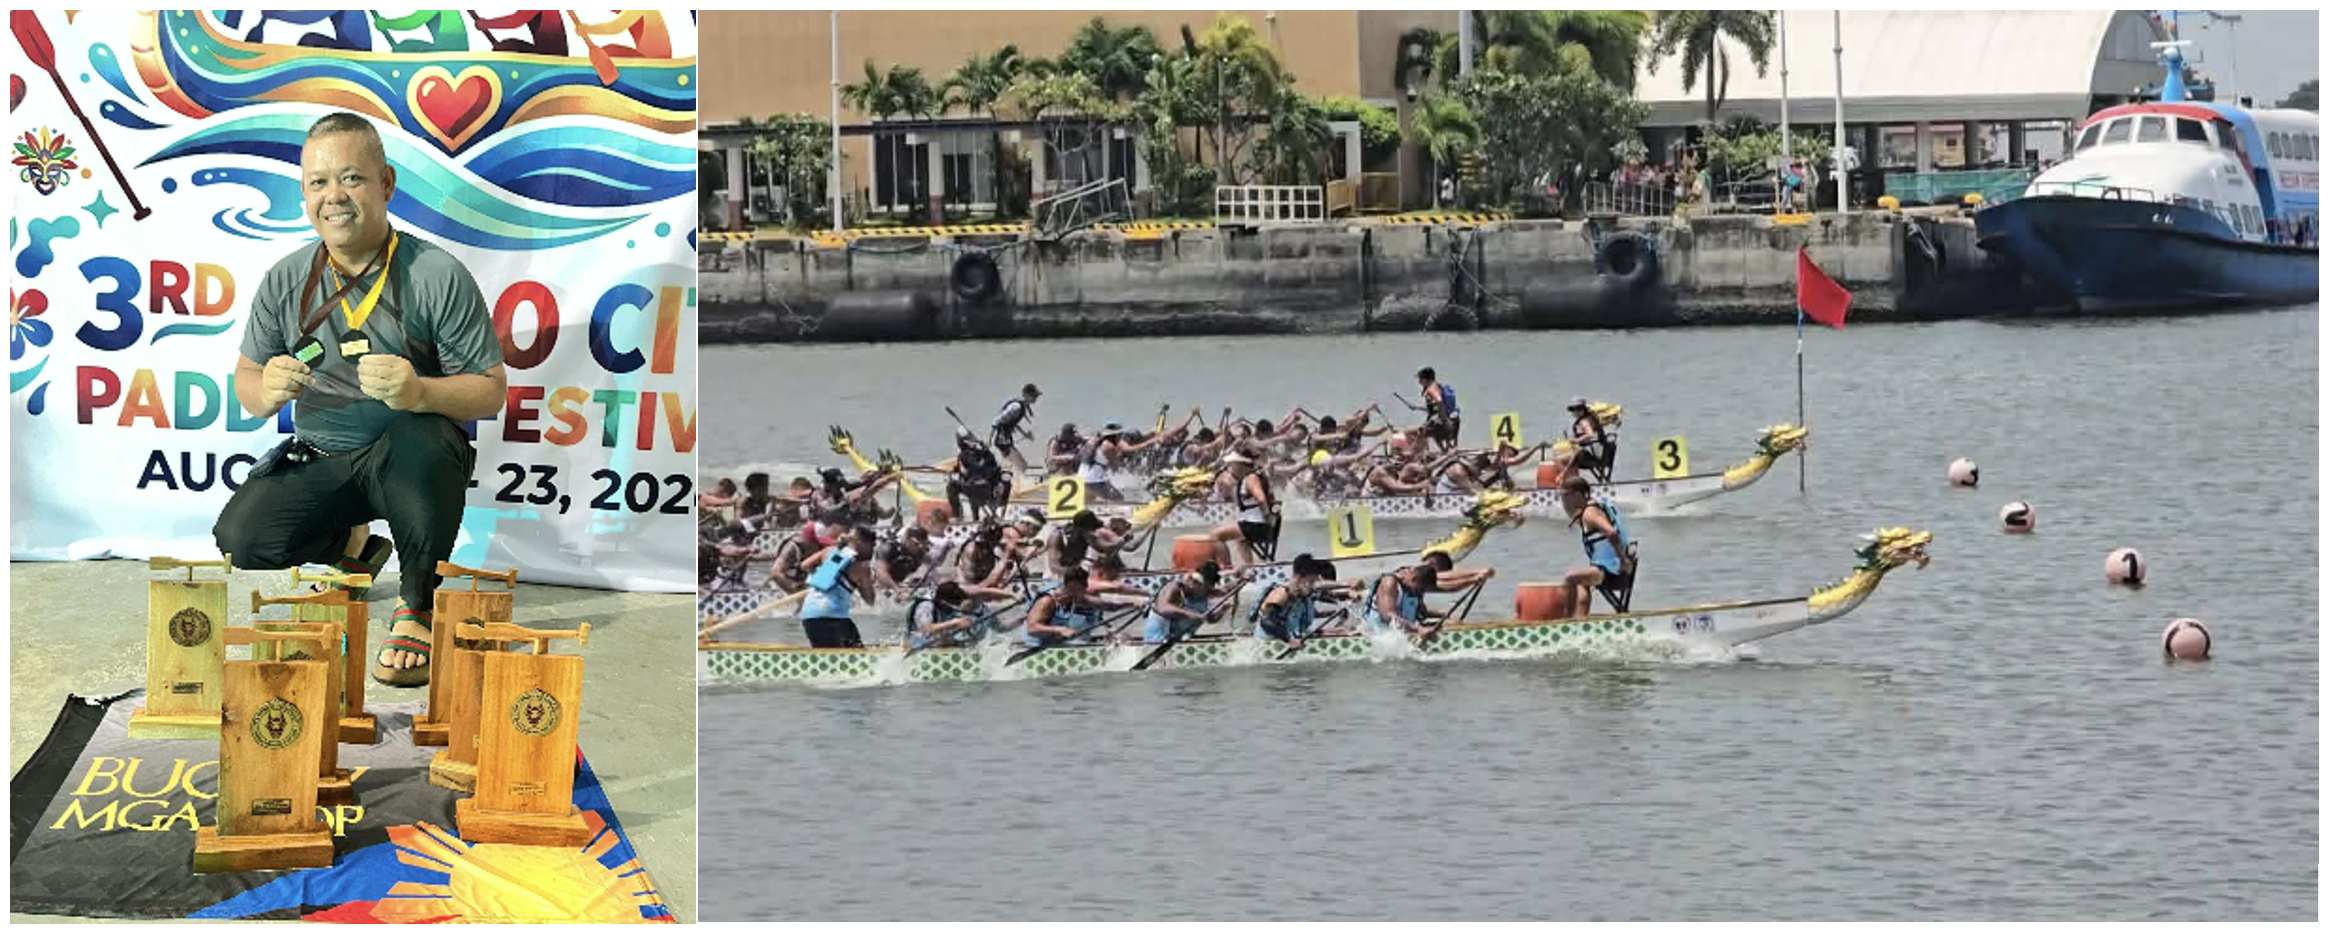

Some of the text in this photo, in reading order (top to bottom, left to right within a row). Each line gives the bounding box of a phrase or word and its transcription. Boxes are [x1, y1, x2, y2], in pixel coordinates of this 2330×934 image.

[75, 256, 236, 351] 3RD
[589, 283, 696, 374] CI
[464, 385, 696, 453] ESTIV
[1496, 416, 1515, 442] 4
[1658, 440, 1681, 471] 3
[495, 463, 571, 514] 23,
[590, 469, 696, 514] 202
[1055, 479, 1078, 512] 2
[1338, 510, 1365, 548] 1
[2004, 502, 2029, 526] 2
[2122, 552, 2141, 585] 1
